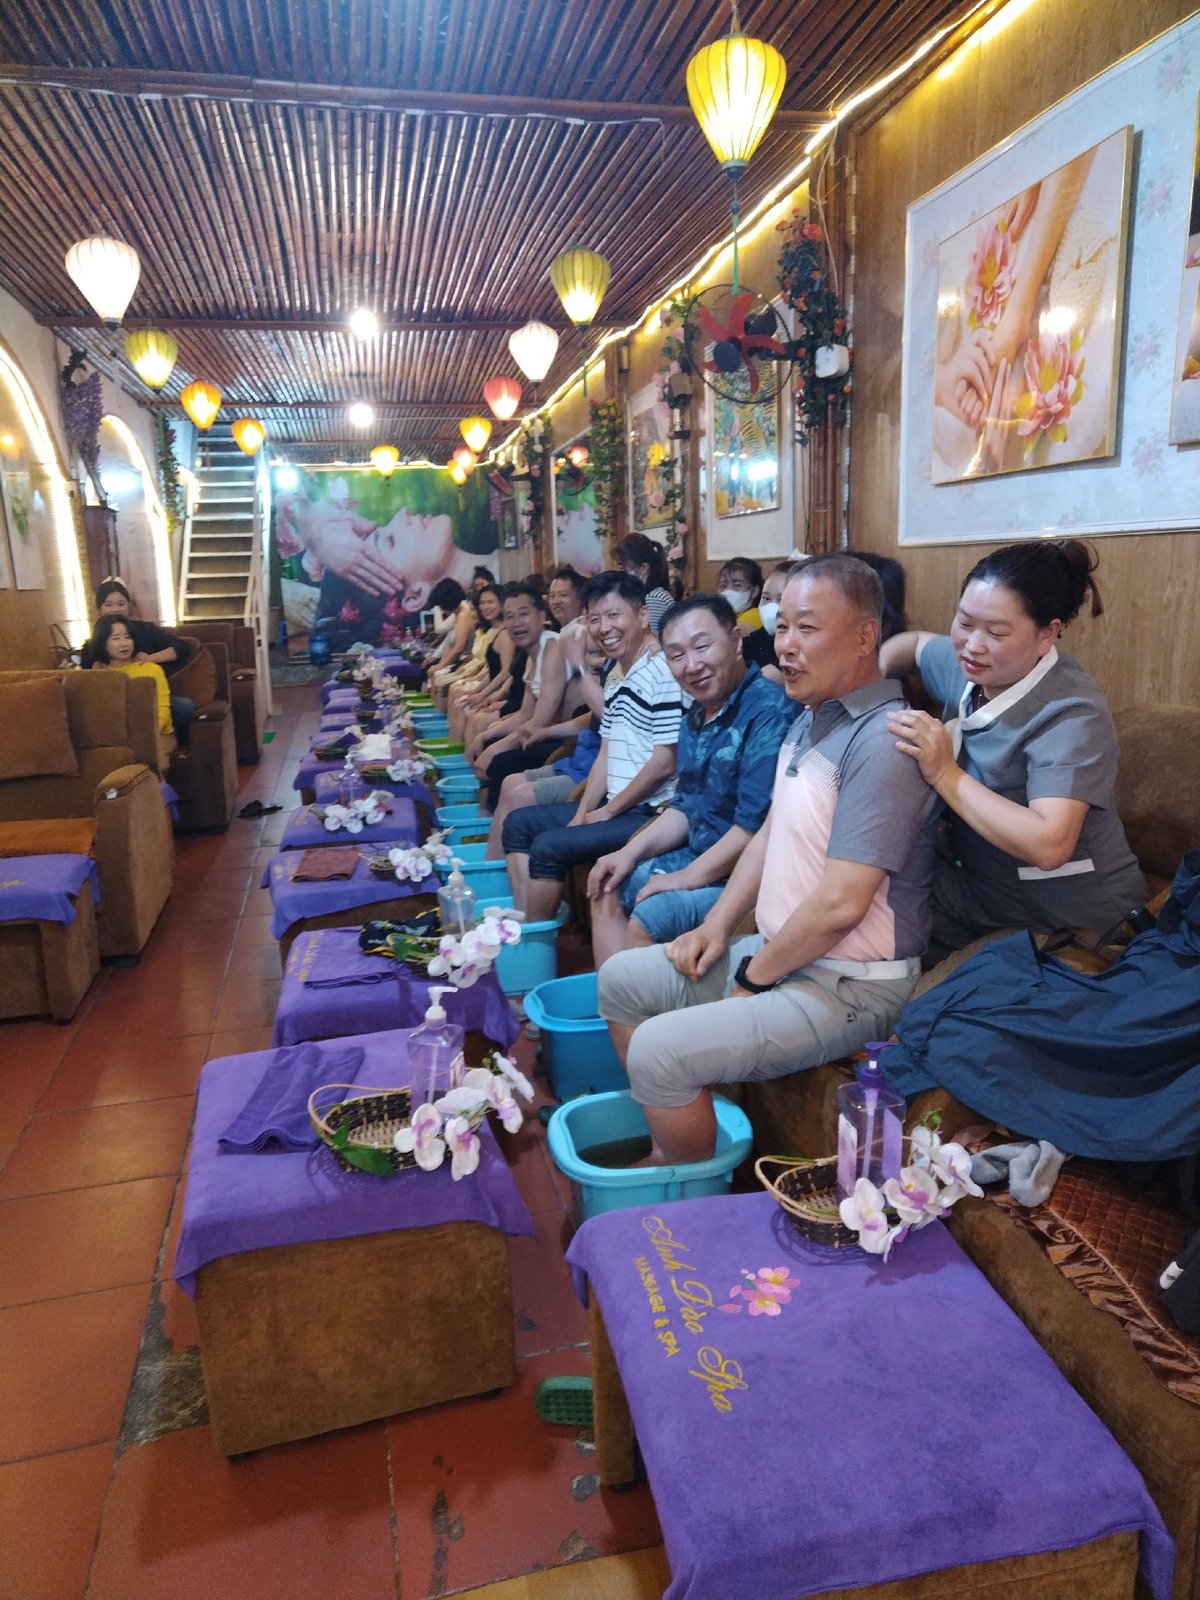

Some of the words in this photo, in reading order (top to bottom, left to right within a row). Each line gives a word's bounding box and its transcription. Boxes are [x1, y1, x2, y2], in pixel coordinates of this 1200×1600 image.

[634, 1256, 667, 1313] MASSAGE
[641, 1215, 697, 1272] Anh
[688, 1346, 749, 1414] Spa
[653, 1318, 670, 1328] &
[656, 1331, 681, 1357] SPA
